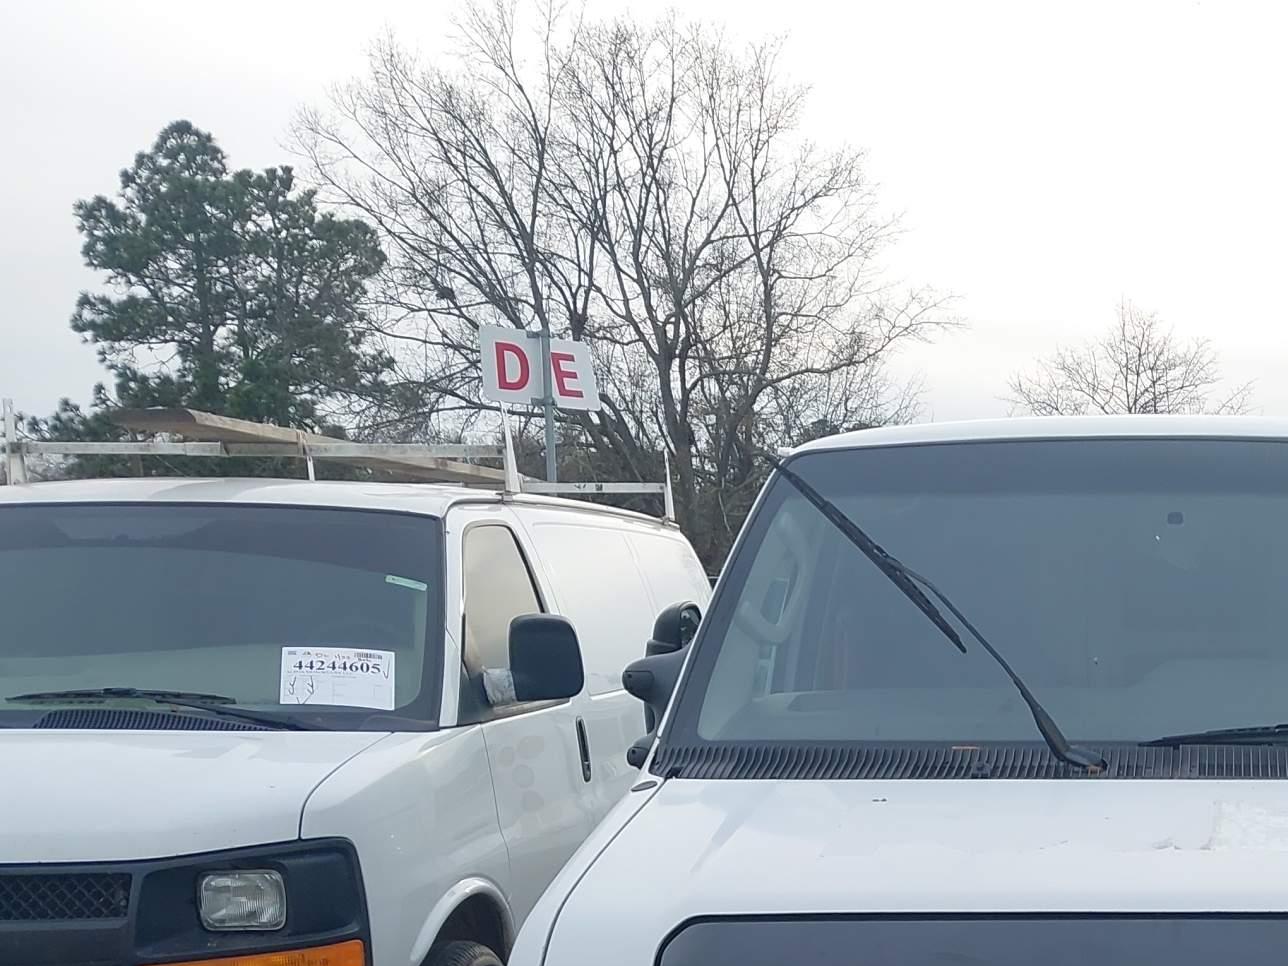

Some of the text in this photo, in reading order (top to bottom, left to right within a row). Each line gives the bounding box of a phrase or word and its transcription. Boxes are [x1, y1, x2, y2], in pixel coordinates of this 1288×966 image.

[495, 342, 530, 391] D
[551, 352, 584, 398] E
[292, 660, 381, 674] 44244605
